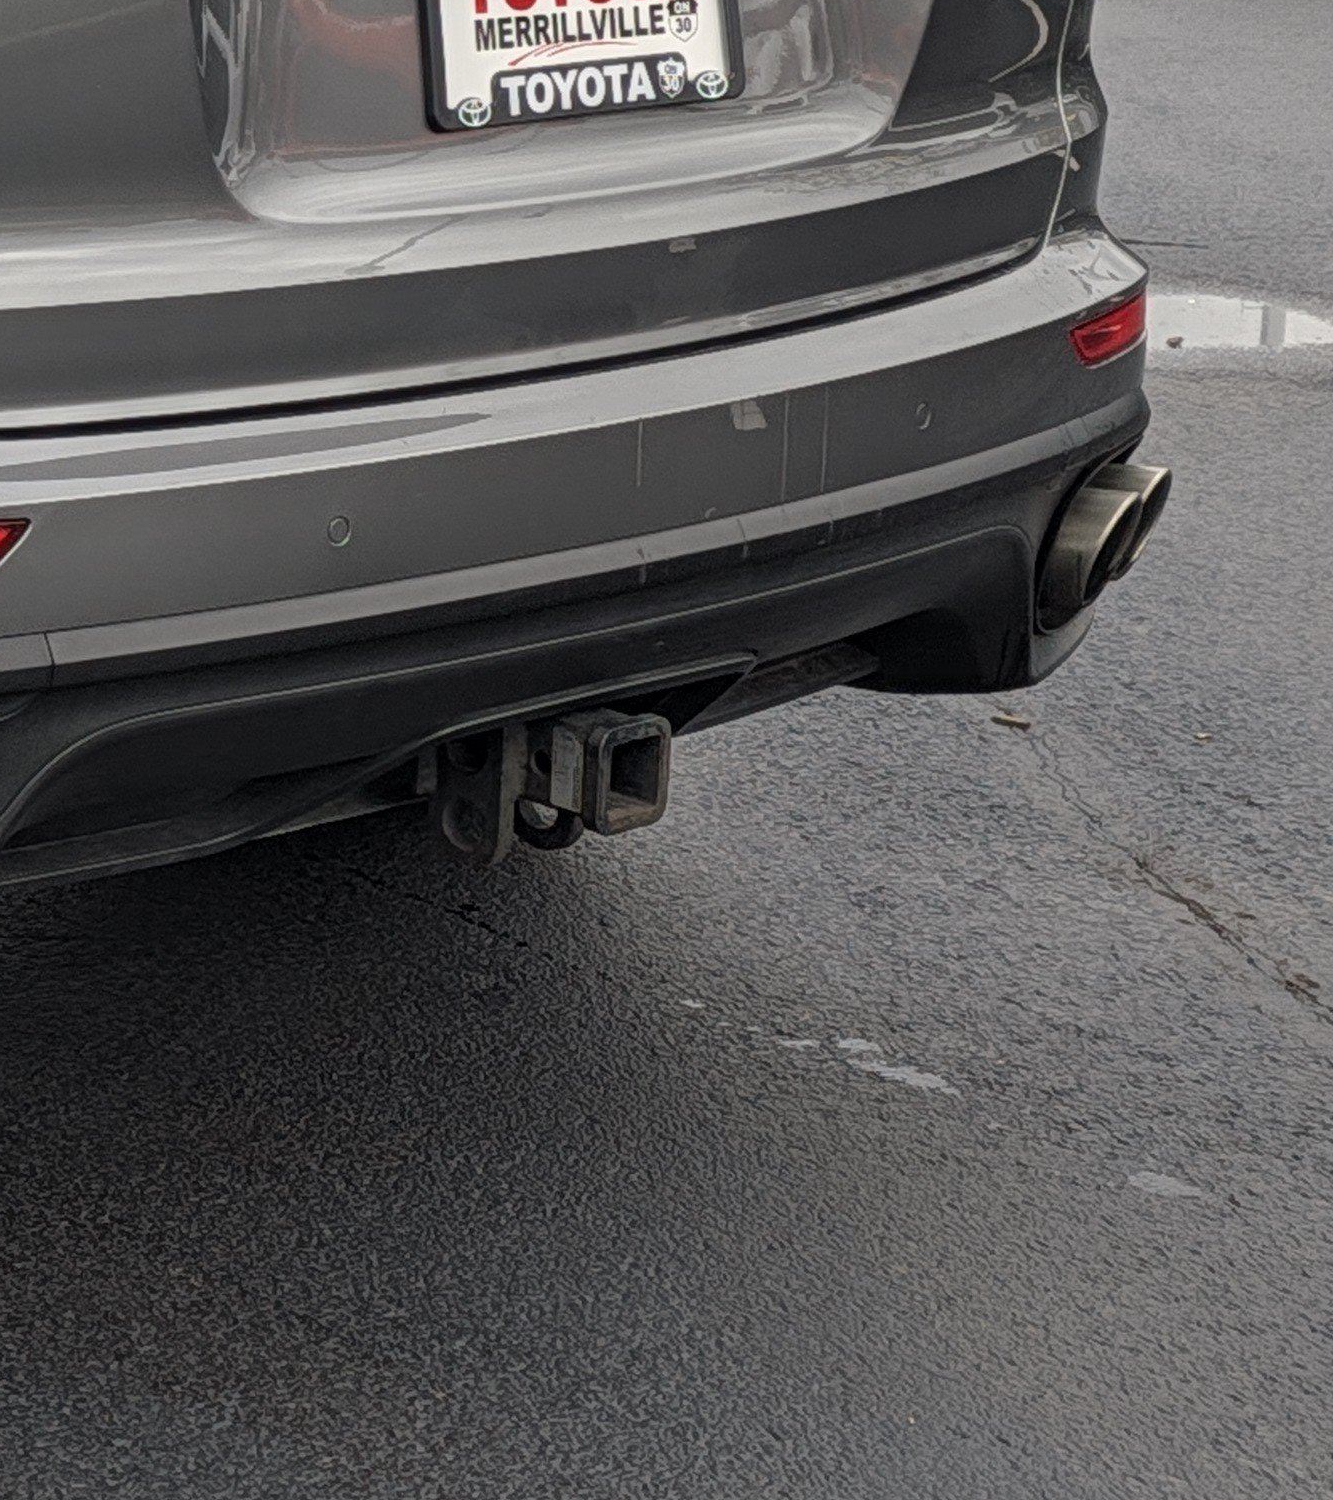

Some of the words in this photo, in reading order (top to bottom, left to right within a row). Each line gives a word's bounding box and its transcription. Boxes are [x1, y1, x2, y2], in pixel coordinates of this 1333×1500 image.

[473, 4, 667, 52] MERRILLVILLE
[675, 17, 693, 35] 30
[500, 61, 657, 117] TOYOTA
